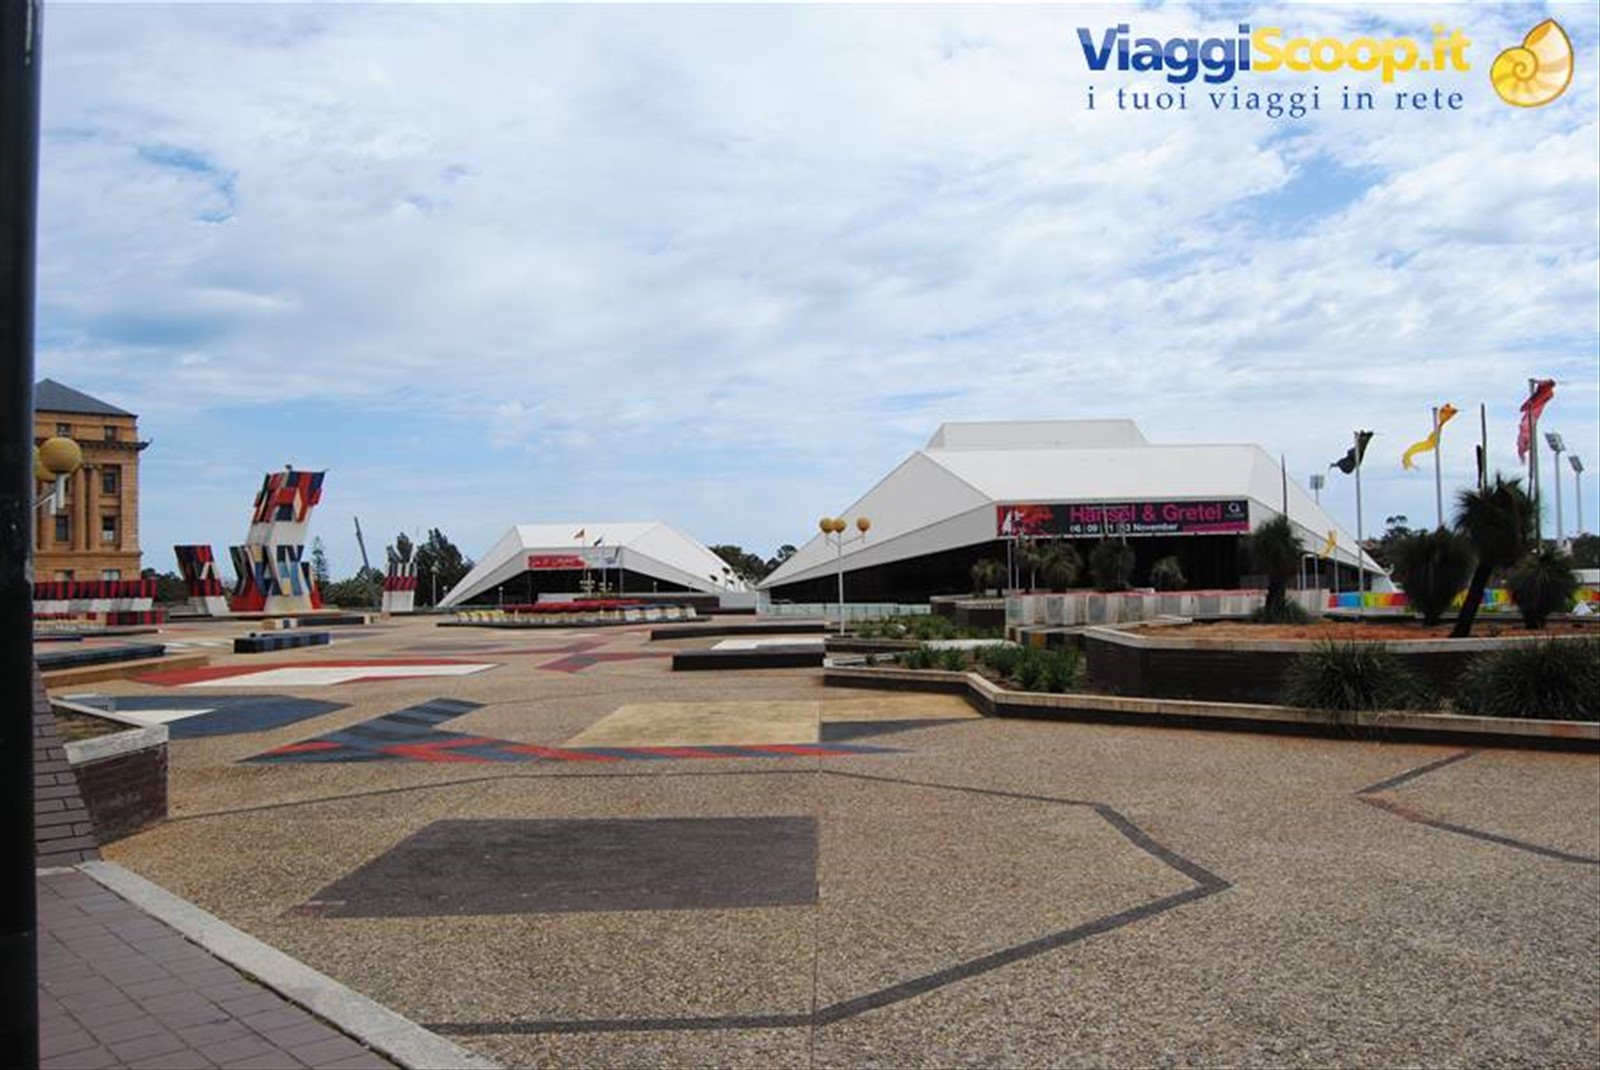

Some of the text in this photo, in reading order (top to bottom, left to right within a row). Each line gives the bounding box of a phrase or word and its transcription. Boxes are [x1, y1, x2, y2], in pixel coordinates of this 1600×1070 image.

[1142, 504, 1156, 522] &
[1162, 503, 1222, 522] Gretel
[1133, 522, 1179, 533] November
